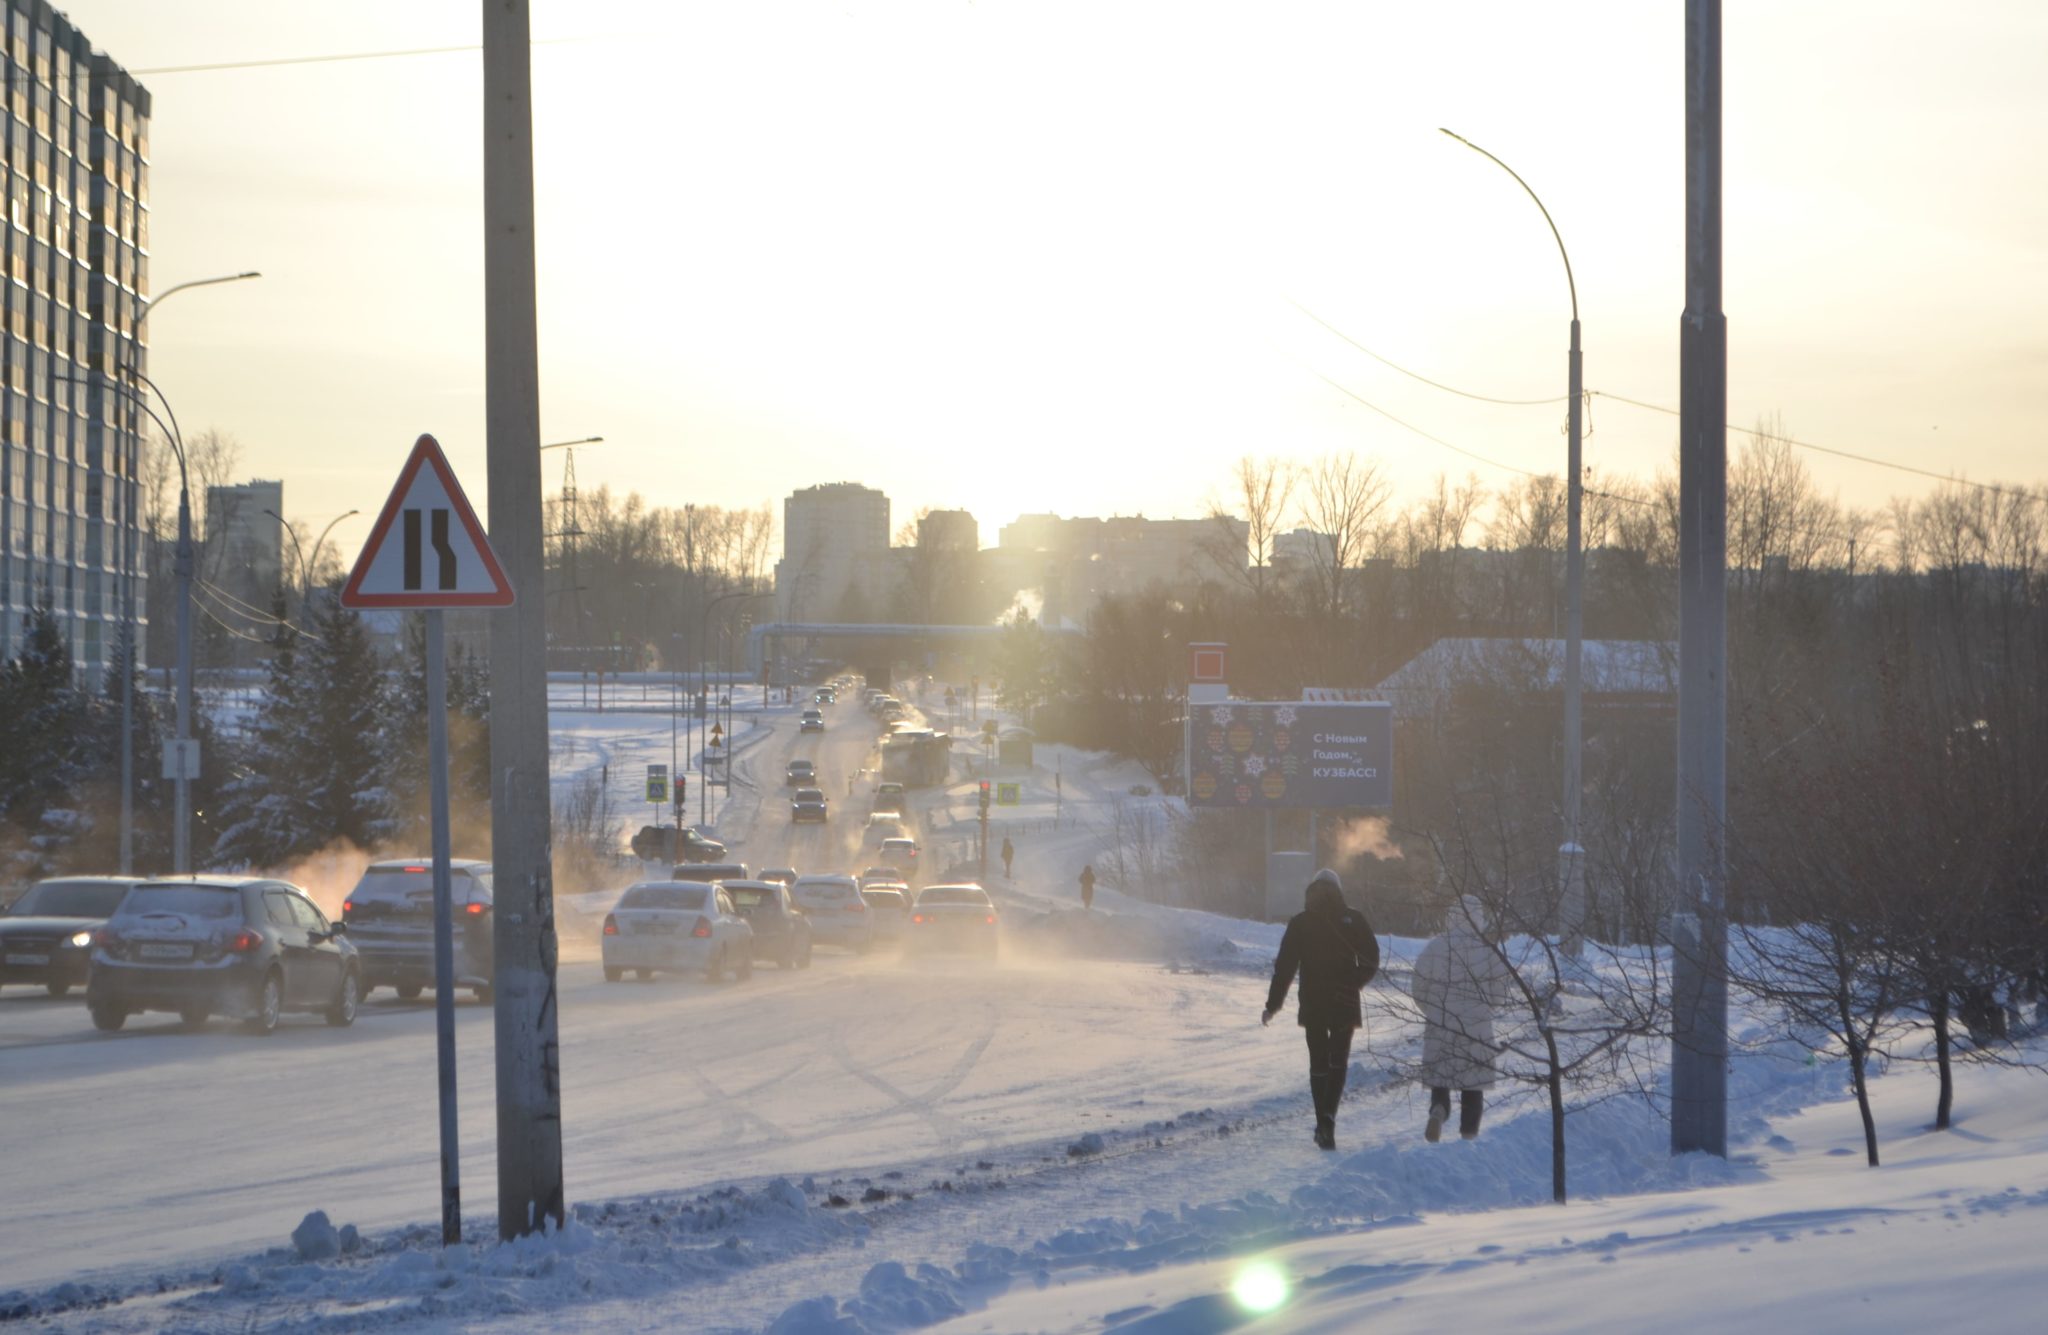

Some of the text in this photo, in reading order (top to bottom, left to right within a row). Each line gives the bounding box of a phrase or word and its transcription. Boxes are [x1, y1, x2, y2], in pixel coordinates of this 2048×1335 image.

[1313, 733, 1367, 743] С Новым
[1313, 768, 1377, 778] КУЗБАСС!
